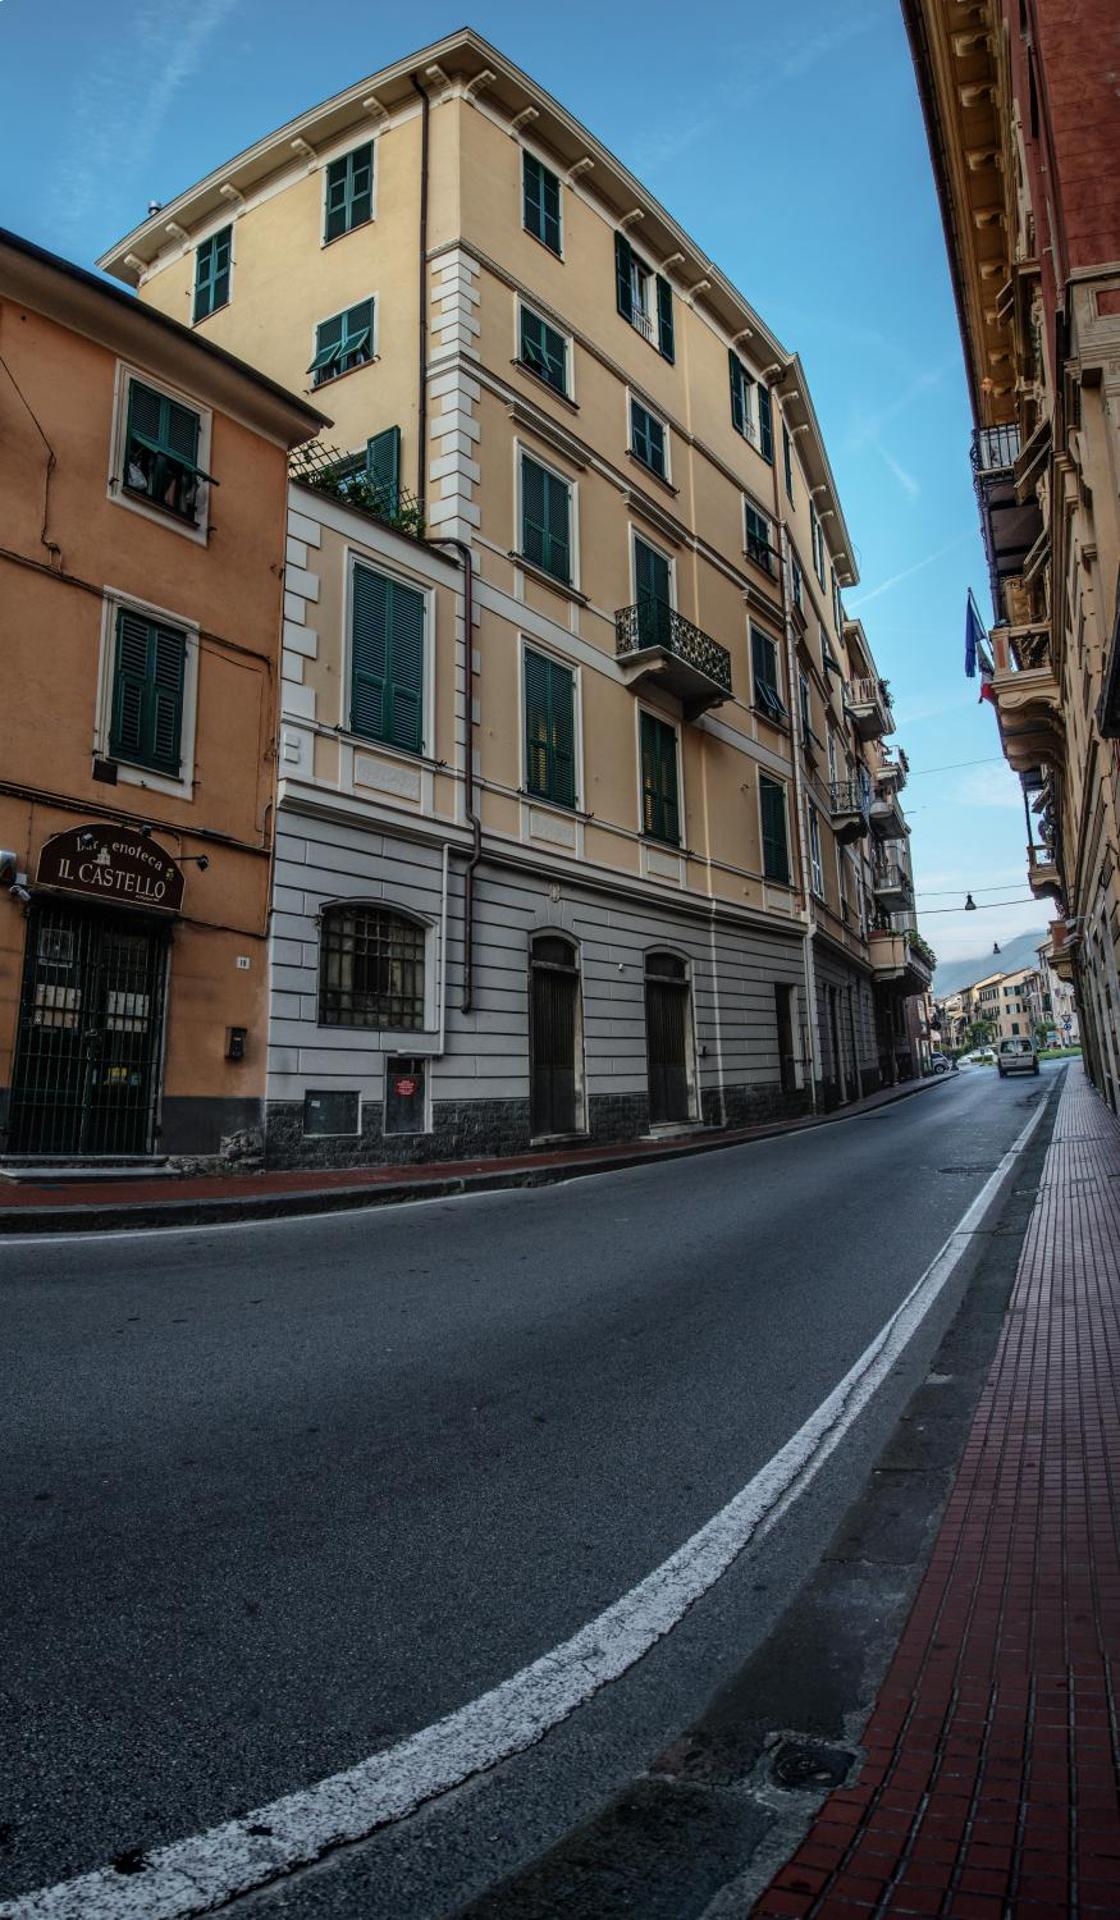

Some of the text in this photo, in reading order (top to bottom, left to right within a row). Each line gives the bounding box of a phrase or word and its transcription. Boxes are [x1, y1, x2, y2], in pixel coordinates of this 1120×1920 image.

[112, 841, 163, 871] enoteca
[58, 858, 166, 898] IL CASTELLO
